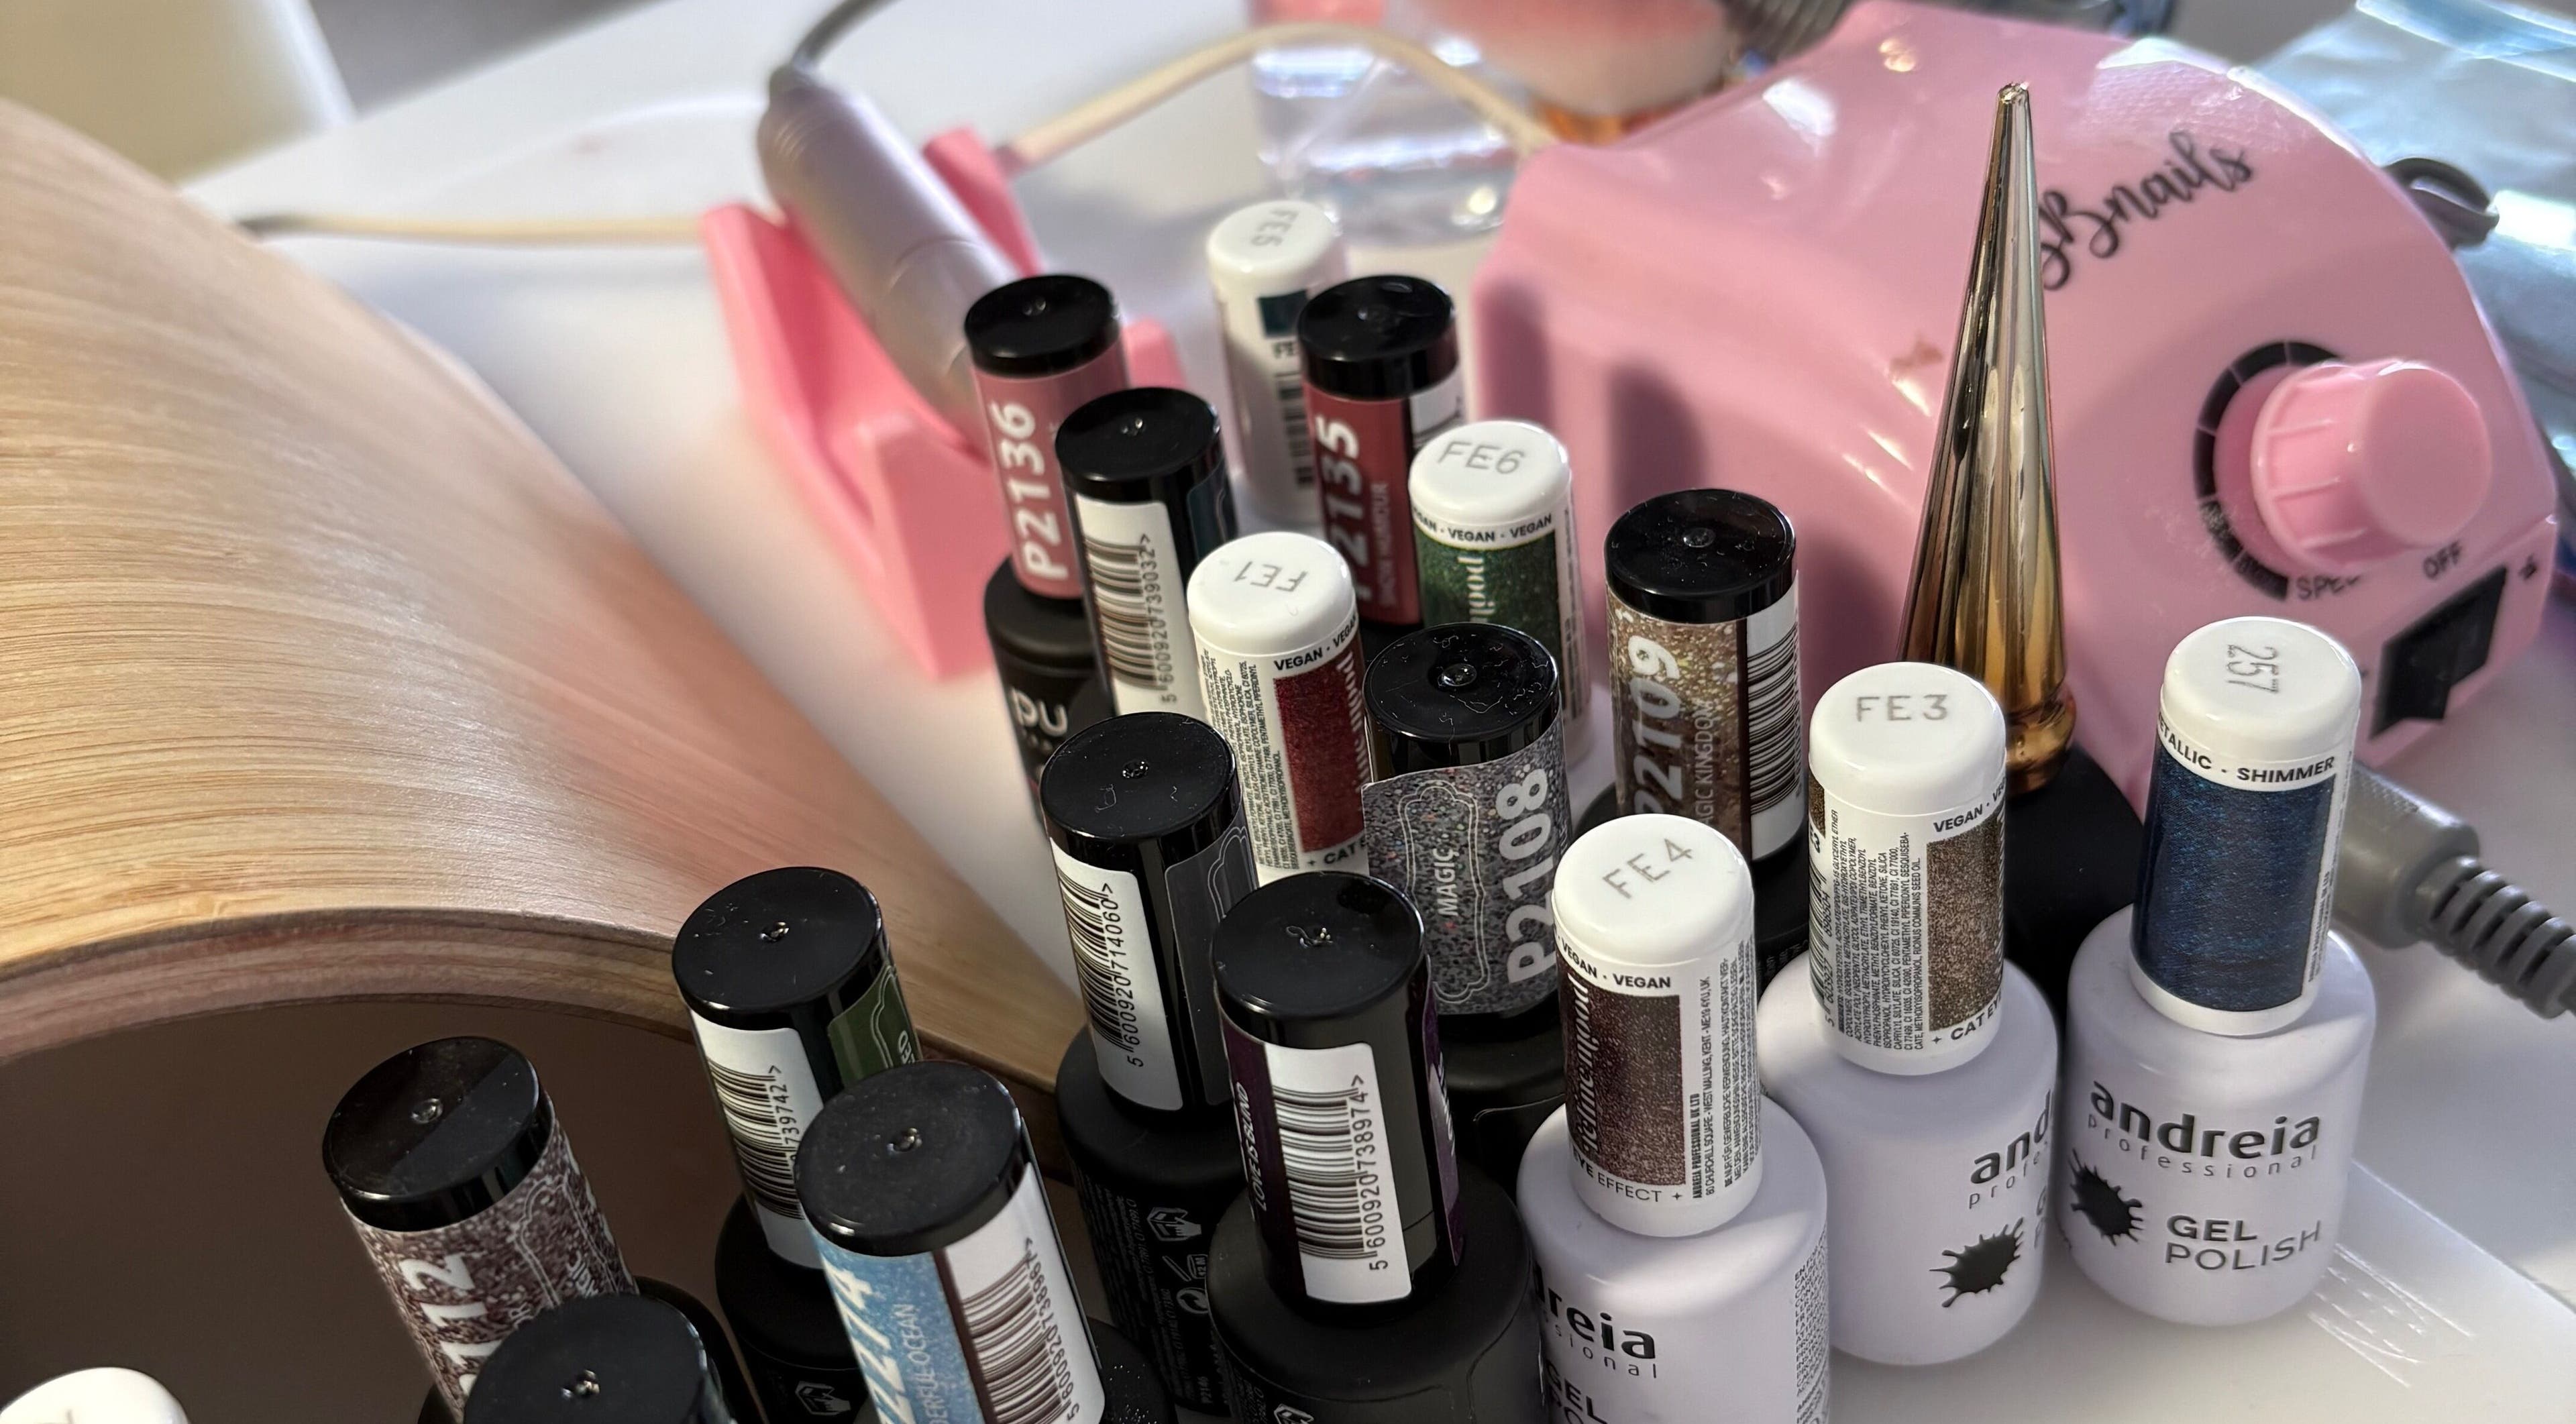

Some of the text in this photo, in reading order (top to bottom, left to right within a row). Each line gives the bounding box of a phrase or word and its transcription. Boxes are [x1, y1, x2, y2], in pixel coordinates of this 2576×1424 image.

[1437, 439, 1527, 476] FE6
[988, 401, 1069, 582] P2136
[1315, 414, 1372, 602] 2135
[1448, 527, 1495, 543] VEGAN
[1509, 512, 1552, 539] VEGAN
[1233, 559, 1310, 594] FE1
[2422, 541, 2463, 580] OFF
[1274, 646, 1323, 671] VEGAN
[2226, 643, 2282, 695] 257
[1855, 694, 1948, 722] FE3
[2237, 755, 2335, 784] SHIMMER
[1695, 789, 1713, 825] AGIC
[1933, 803, 1983, 833] VEGAN
[1324, 842, 1356, 865] CAT
[1601, 837, 1695, 900] FE4
[1878, 853, 1887, 873] SILICA
[1433, 848, 1458, 916] MAGIC
[1495, 769, 1558, 983] P2108
[1911, 873, 1921, 890] SEED
[1561, 938, 1671, 989] VEGAN VEGAN
[1950, 1011, 1985, 1040] CAT
[1127, 1055, 1144, 1067] 5
[1236, 1082, 1255, 1144] BLIND
[1703, 1091, 1713, 1110] WEST
[2089, 1079, 2320, 1160] andreia
[1690, 1093, 1702, 1199] ANDREIA PROFESSIONAL UK LTD
[2088, 1113, 2317, 1179] professional
[1597, 1172, 1662, 1203] EFFECT
[2165, 1219, 2322, 1272] POLISH
[2166, 1214, 2258, 1242] GEL
[1369, 1260, 1388, 1270] 5
[820, 1253, 917, 1424] 2274
[893, 1304, 930, 1364] OCEAN
